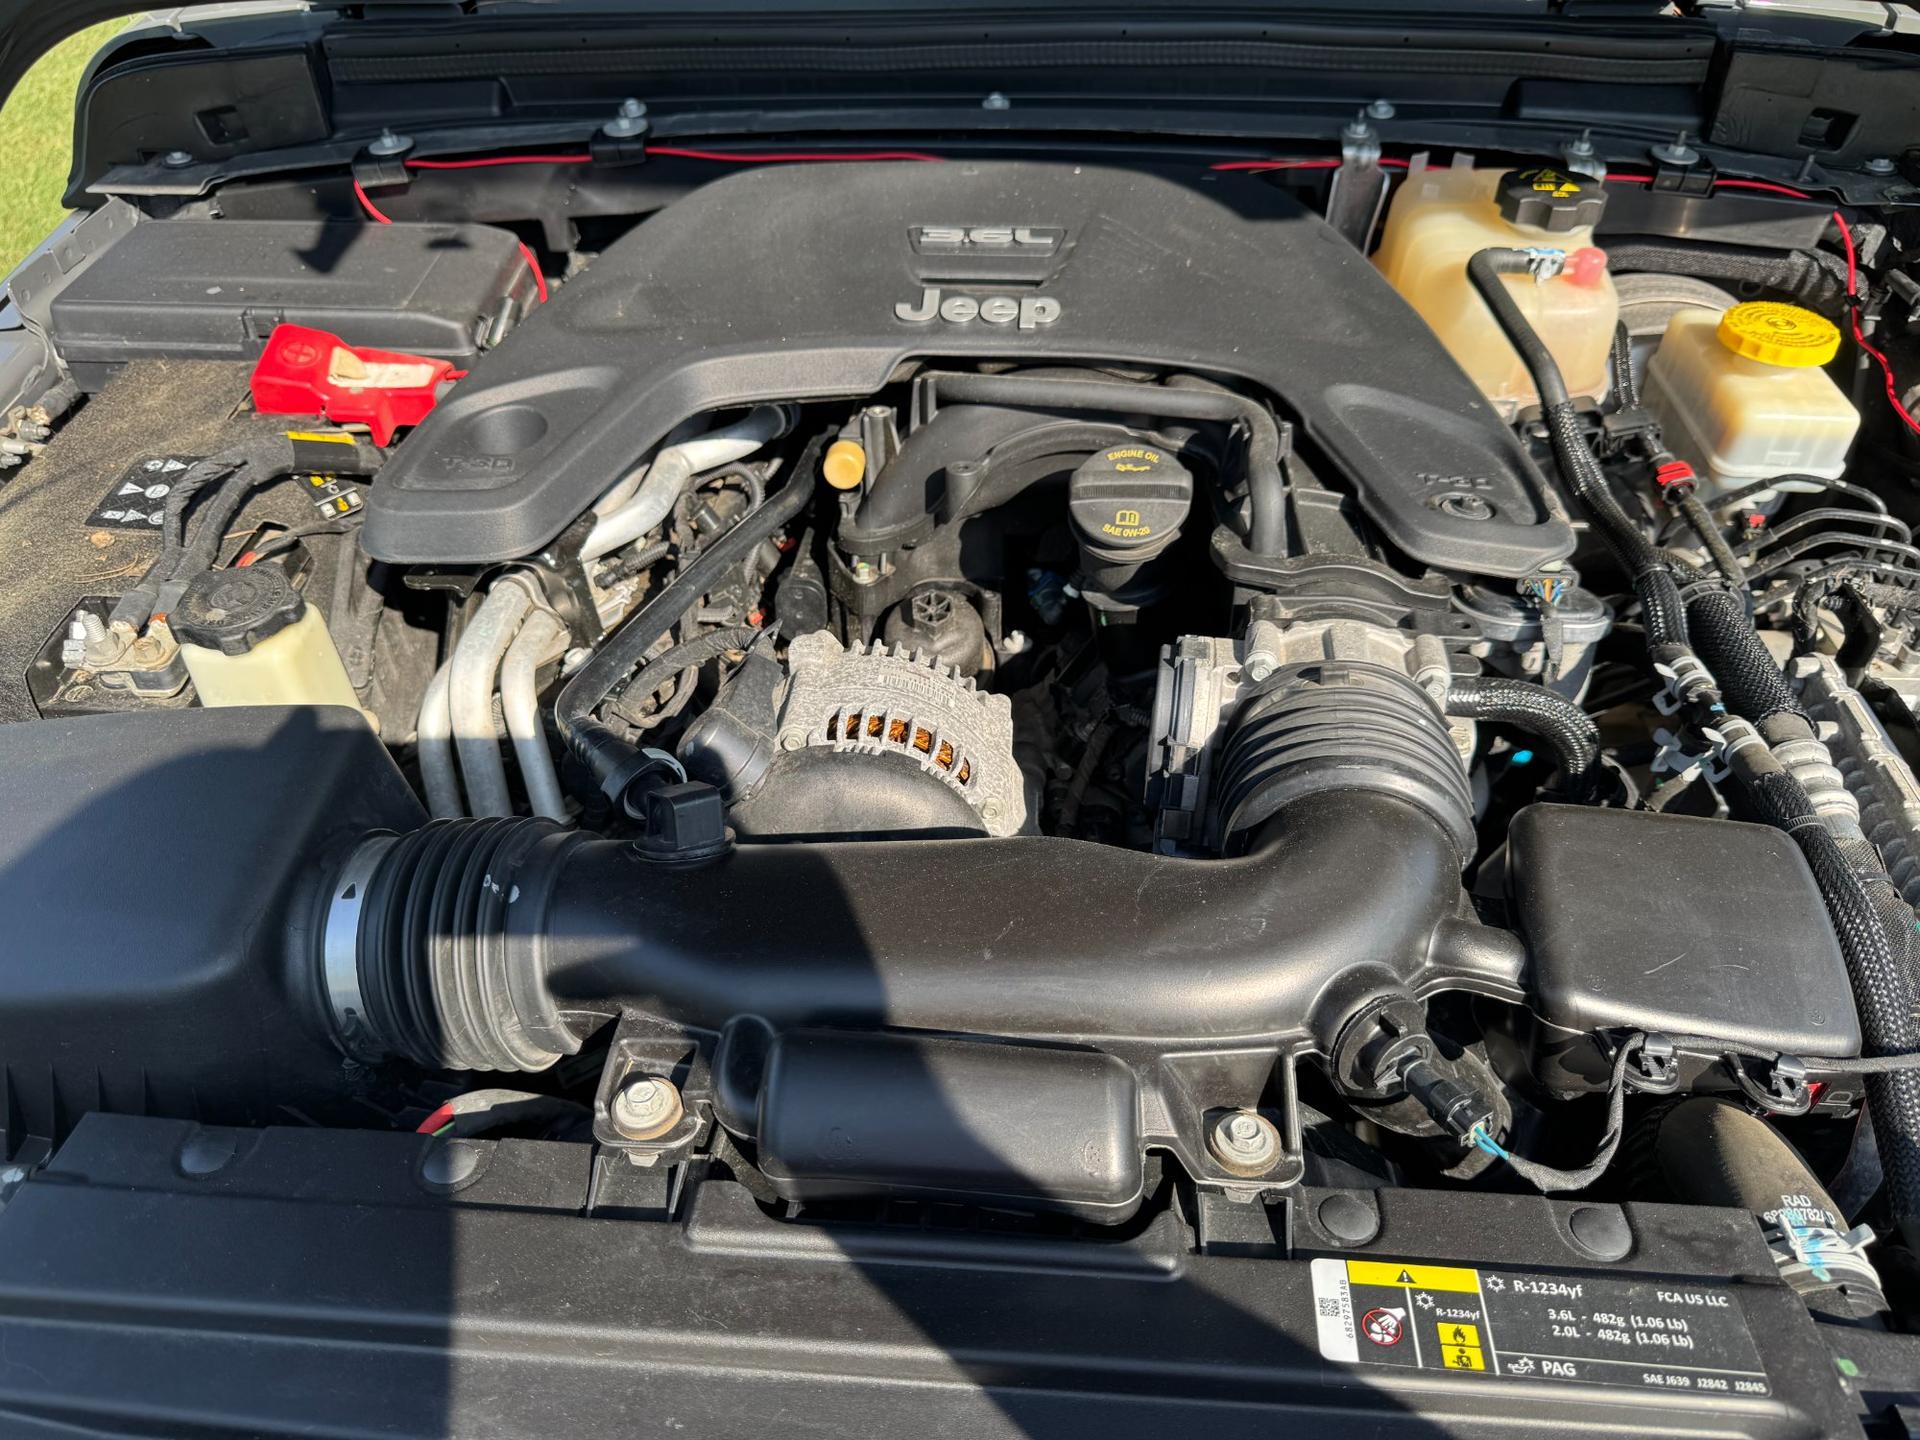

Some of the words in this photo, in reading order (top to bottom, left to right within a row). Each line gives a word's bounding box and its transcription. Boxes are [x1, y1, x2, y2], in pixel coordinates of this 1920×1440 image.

[920, 228, 1054, 246] 3.6L
[894, 287, 1062, 329] Jeep
[1107, 449, 1145, 462] ENGINE
[1145, 451, 1160, 464] OIL
[1102, 523, 1122, 537] SAE
[1122, 526, 1151, 538] 0W-20
[1780, 1194, 1812, 1207] RAD
[1513, 1280, 1583, 1299] R-1234yf
[1656, 1291, 1684, 1304] FCA
[1684, 1293, 1704, 1305] US
[1704, 1295, 1729, 1307] LLC
[1339, 1279, 1355, 1339] 68297583AB
[1436, 1307, 1481, 1321] R-1234yf
[1547, 1308, 1577, 1321] 3.6L
[1592, 1312, 1626, 1328] 482g
[1630, 1315, 1665, 1329] (1.06
[1665, 1317, 1689, 1333] Lb)
[1551, 1325, 1581, 1338] 2.0L
[1597, 1329, 1631, 1344] 482g
[1635, 1331, 1670, 1345] (1.06
[1671, 1334, 1694, 1350] Lb)
[1541, 1360, 1577, 1377] PAG
[1643, 1373, 1665, 1385] SAE
[1665, 1375, 1690, 1387] J639
[1697, 1378, 1729, 1390] J2842
[1734, 1381, 1767, 1393] J2845
